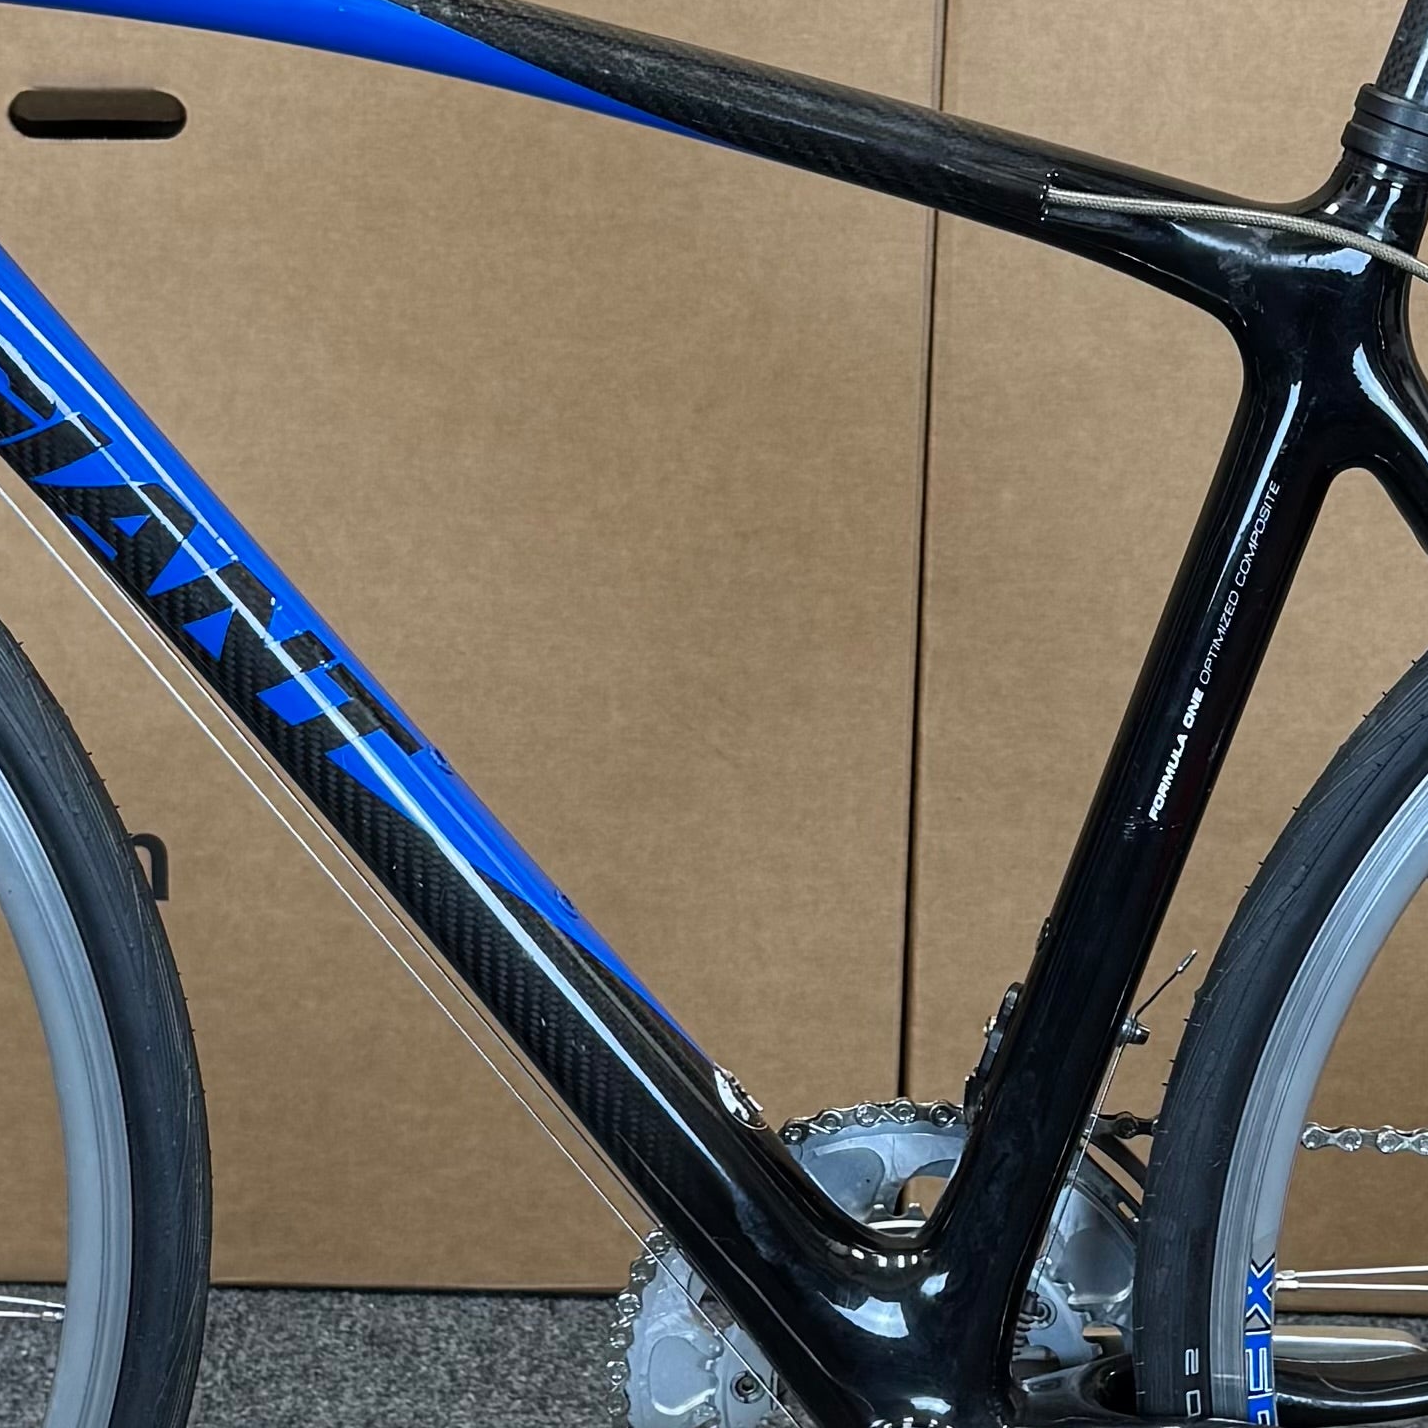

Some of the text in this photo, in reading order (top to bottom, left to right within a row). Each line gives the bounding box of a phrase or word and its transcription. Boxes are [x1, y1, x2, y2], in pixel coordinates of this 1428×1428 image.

[1148, 480, 1281, 822] FORMULA ONE OPTIMIZED COMPOSITE
